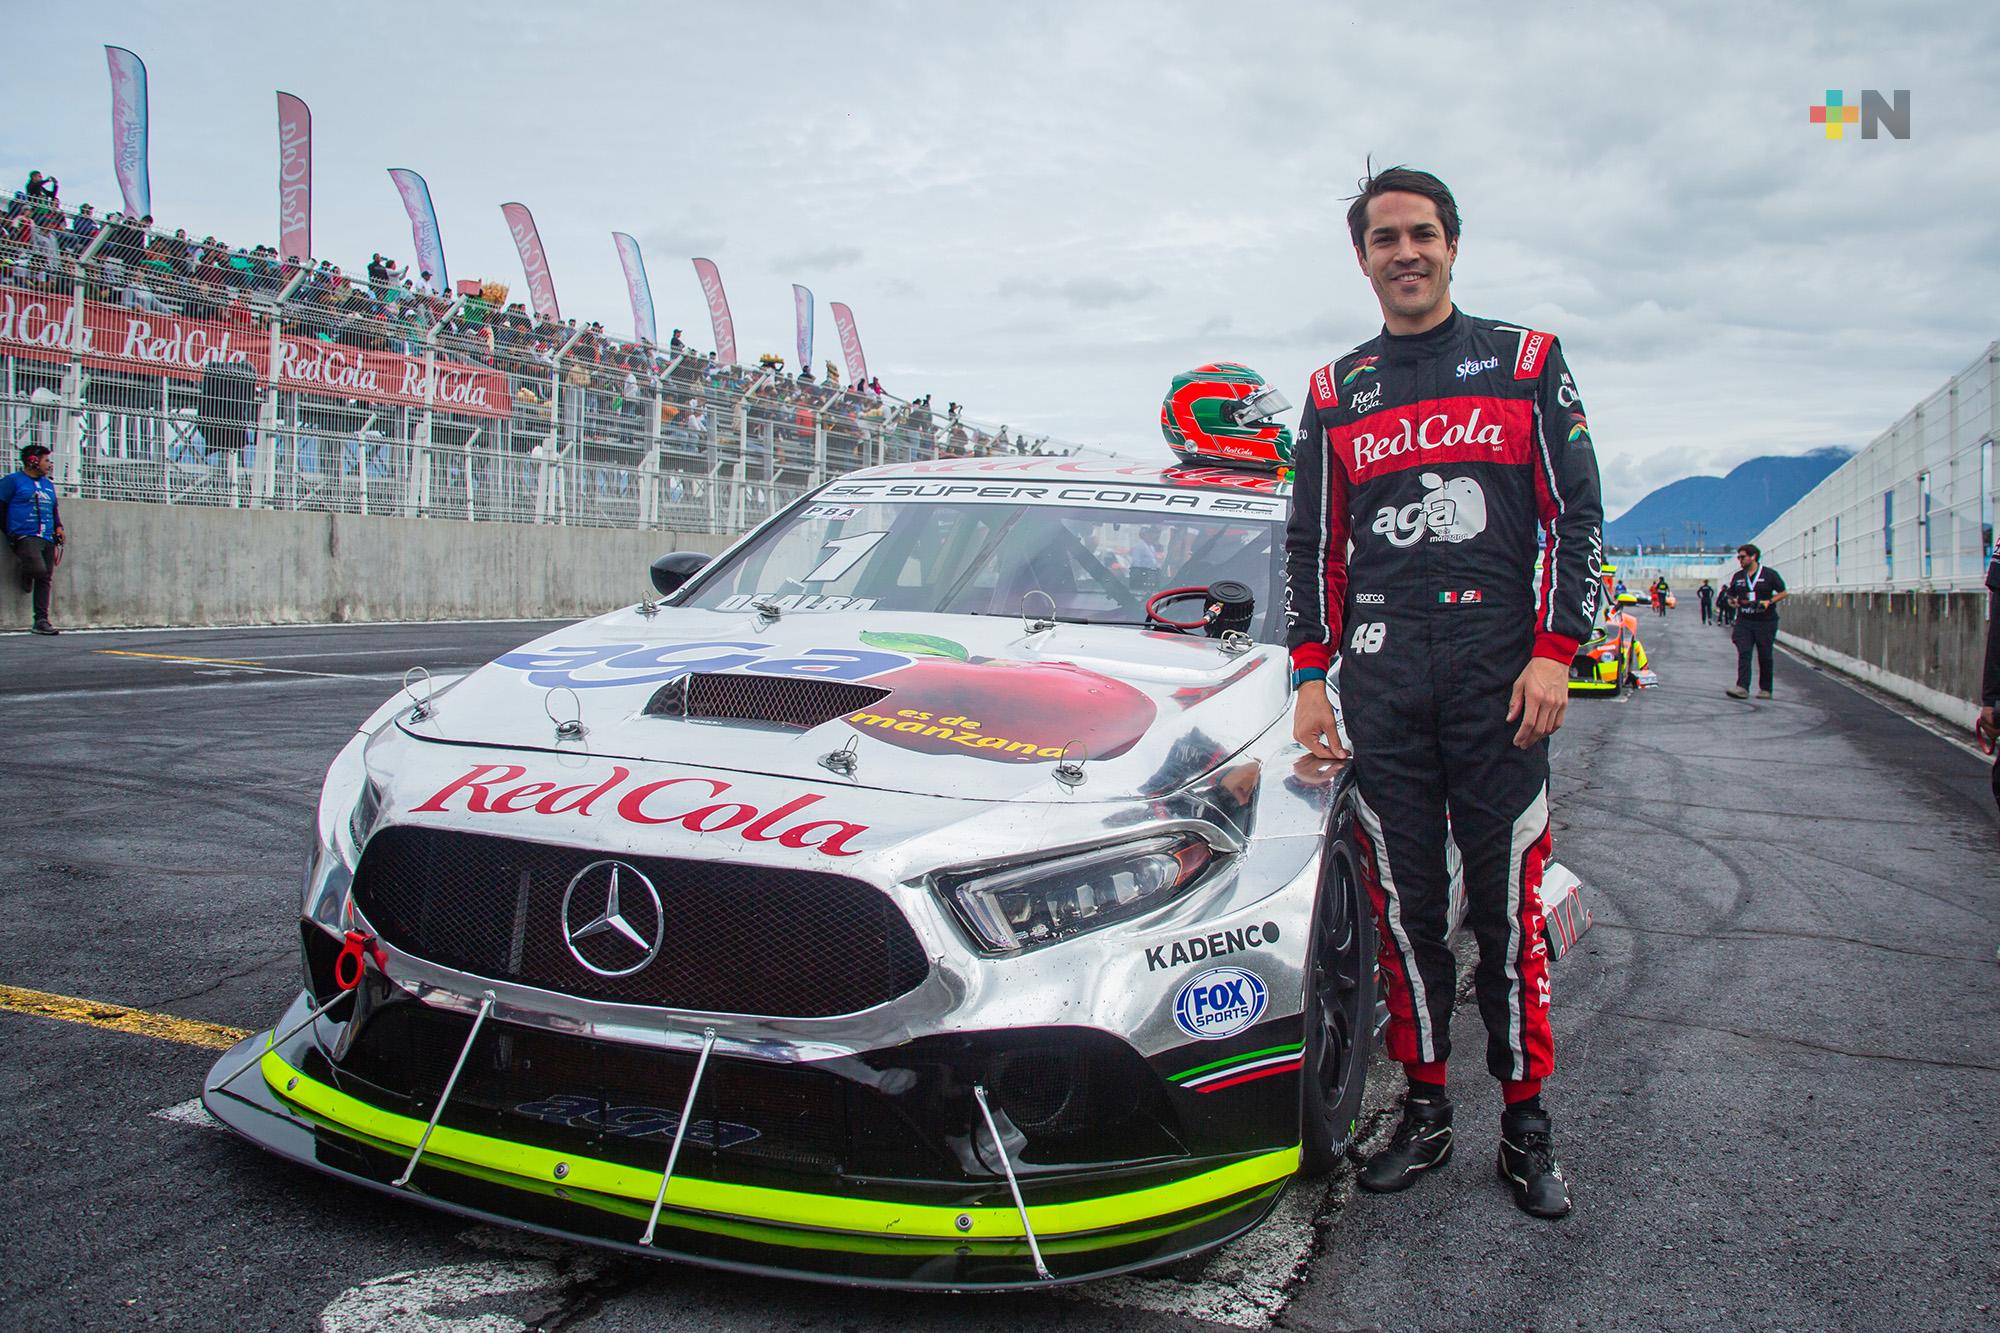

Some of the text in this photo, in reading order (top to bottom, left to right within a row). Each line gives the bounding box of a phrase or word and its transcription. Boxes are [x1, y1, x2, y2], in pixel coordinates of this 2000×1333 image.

[122, 318, 183, 363] Red
[1521, 334, 1543, 372] sparco
[279, 342, 379, 391] Red Cola
[440, 370, 488, 407] Cola
[1349, 382, 1382, 410] Red
[1357, 399, 1381, 414] Cola
[1352, 407, 1505, 472] Red Cola
[1057, 488, 1201, 508] COPA
[1209, 498, 1279, 513] SC
[1371, 498, 1457, 549] aga
[800, 531, 890, 583] 1
[1356, 593, 1385, 604] sparco
[1582, 576, 1601, 624] Red
[1350, 622, 1387, 654] 48
[494, 640, 918, 689] aga
[848, 711, 1070, 759] manzana
[896, 707, 983, 731] es de
[408, 763, 871, 858] Red Cola
[1192, 978, 1248, 1017] FOX
[1196, 1006, 1250, 1028] SPORTS
